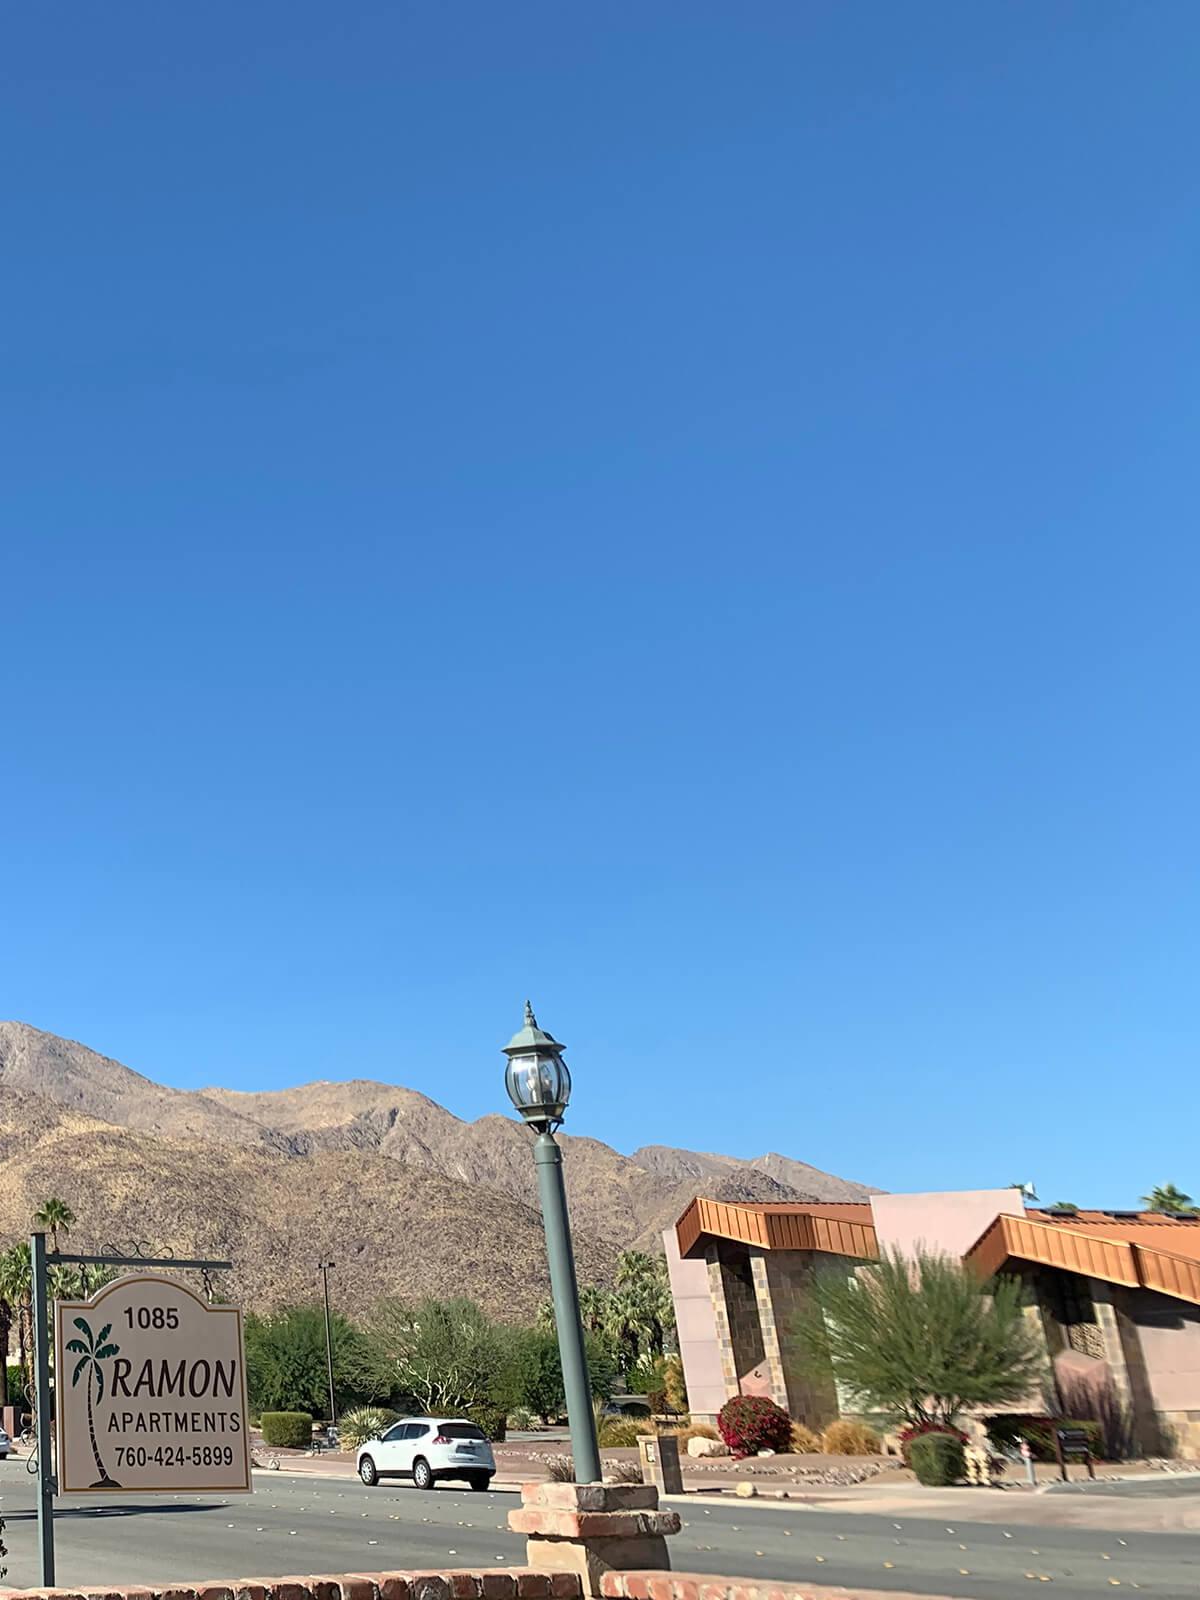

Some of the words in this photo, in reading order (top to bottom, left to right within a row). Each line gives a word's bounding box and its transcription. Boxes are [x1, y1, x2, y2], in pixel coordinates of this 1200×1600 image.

[124, 1306, 179, 1329] 1085
[111, 1358, 236, 1398] RAMON
[107, 1412, 240, 1433] APARTMENTS
[114, 1446, 233, 1467] 760-424-5899
